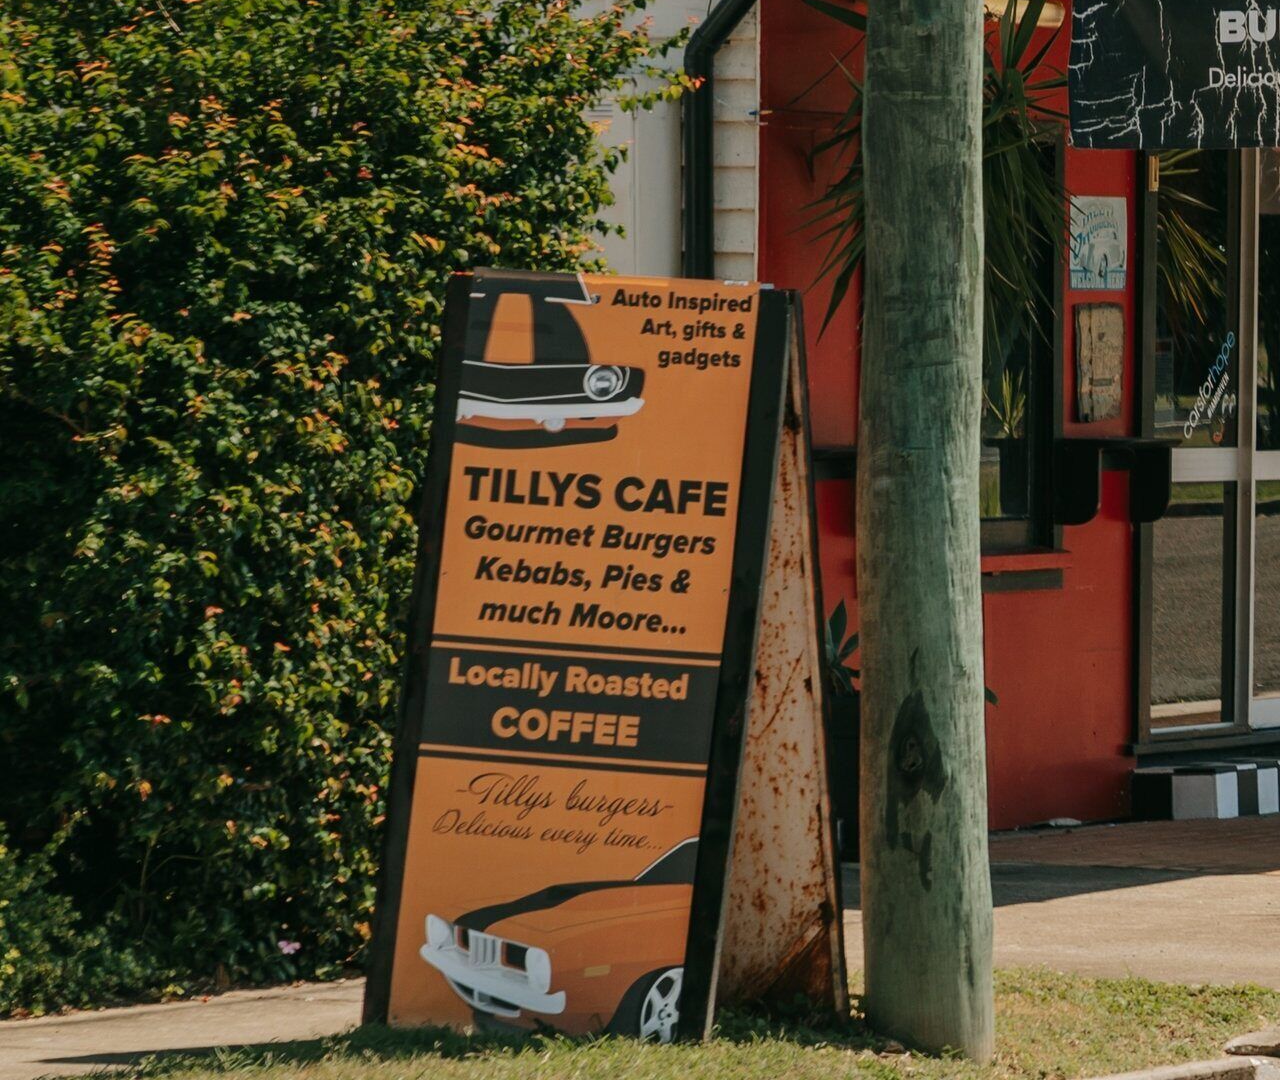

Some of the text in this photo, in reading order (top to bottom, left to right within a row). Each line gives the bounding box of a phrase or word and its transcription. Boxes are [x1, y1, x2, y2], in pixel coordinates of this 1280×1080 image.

[612, 289, 754, 316] Auto Inspired
[641, 318, 746, 342] Art, gifts &
[657, 347, 742, 371] gadgets
[463, 466, 730, 517] TILLYS CAFE
[464, 515, 717, 558] Gourmet Burgers
[474, 556, 692, 595] Kebabs, Pies &
[478, 600, 688, 635] much Moore...
[448, 656, 689, 700] Locally Roasted
[491, 706, 641, 748] COFFEE
[431, 809, 533, 841] Delicious
[540, 826, 601, 855] every
